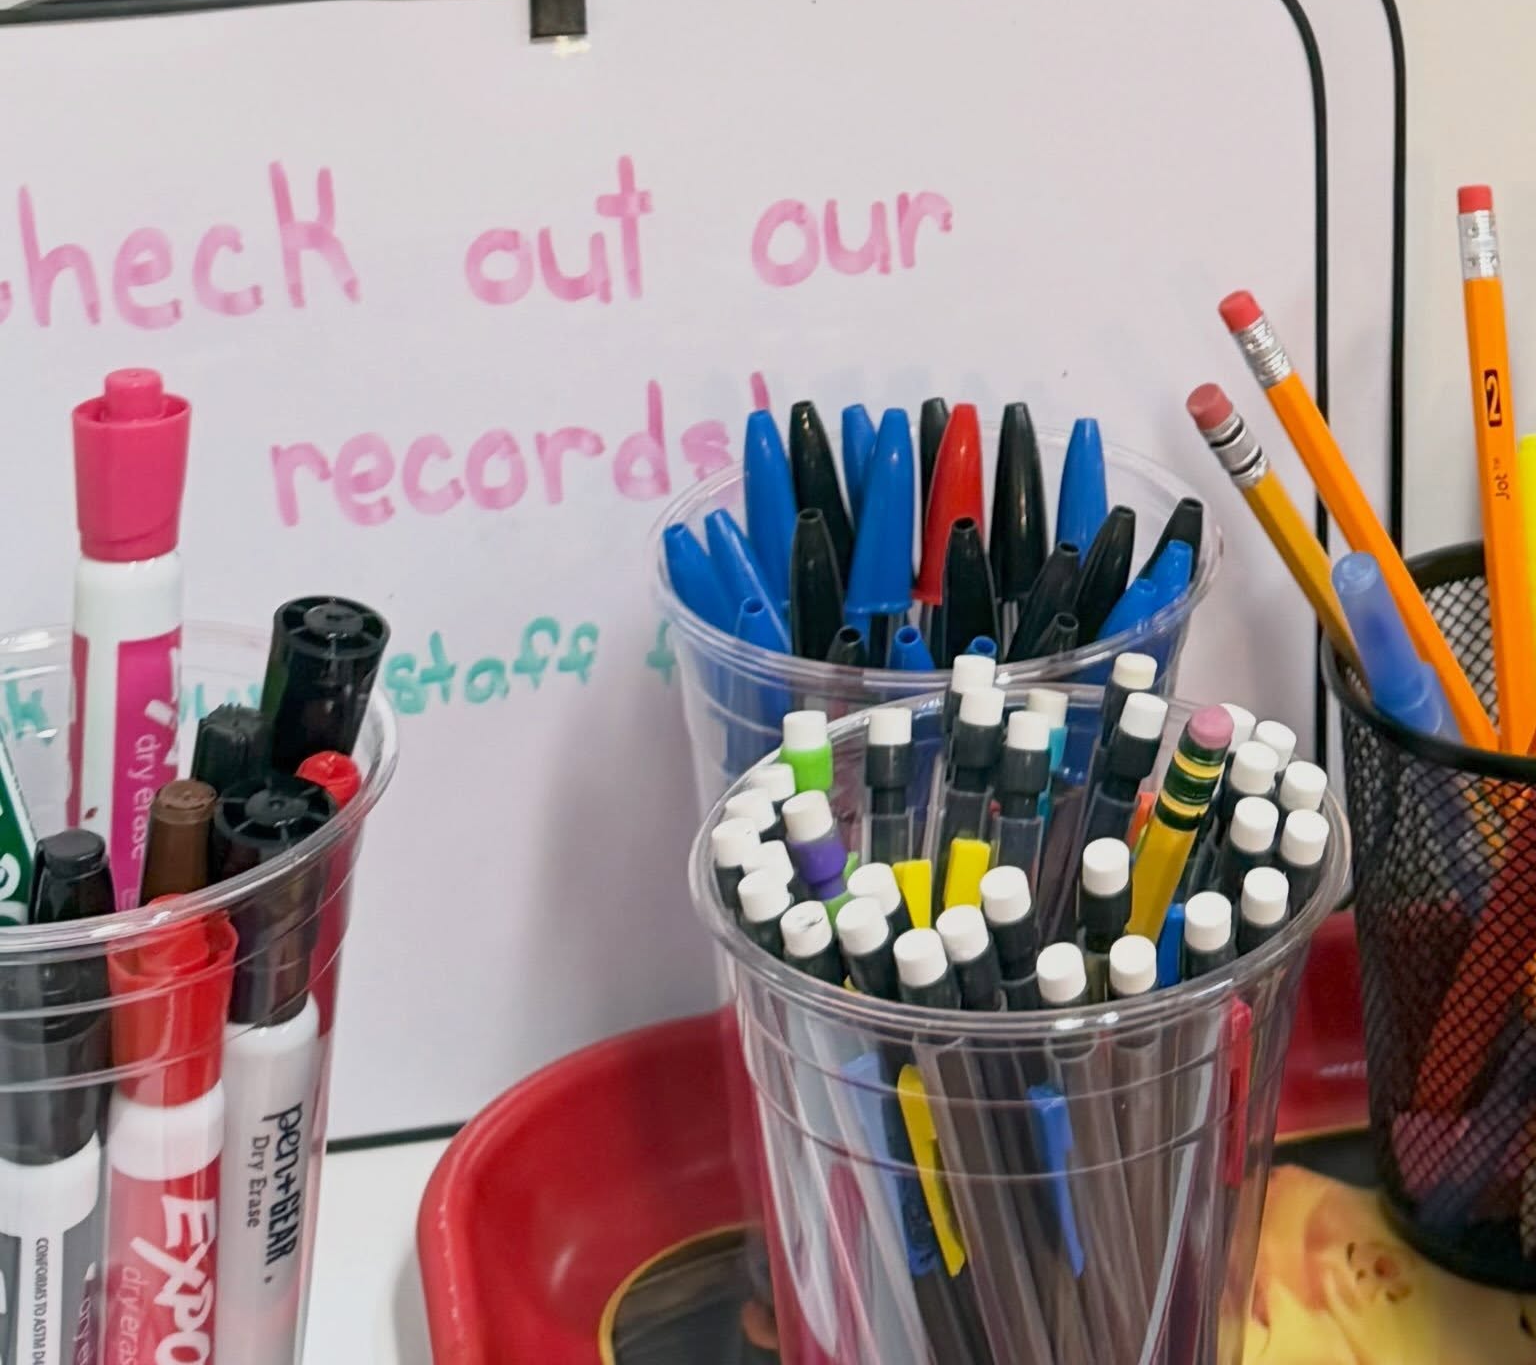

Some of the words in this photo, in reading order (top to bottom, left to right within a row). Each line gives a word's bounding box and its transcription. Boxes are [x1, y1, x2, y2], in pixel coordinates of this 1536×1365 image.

[0, 159, 360, 330] heck
[463, 154, 653, 305] out
[750, 190, 954, 288] our
[384, 615, 600, 715] staff
[128, 733, 161, 779] dry
[248, 1135, 270, 1171] Dry
[247, 1176, 268, 1229] Erase
[130, 1193, 216, 1365] EXPO
[33, 1302, 48, 1317] TO
